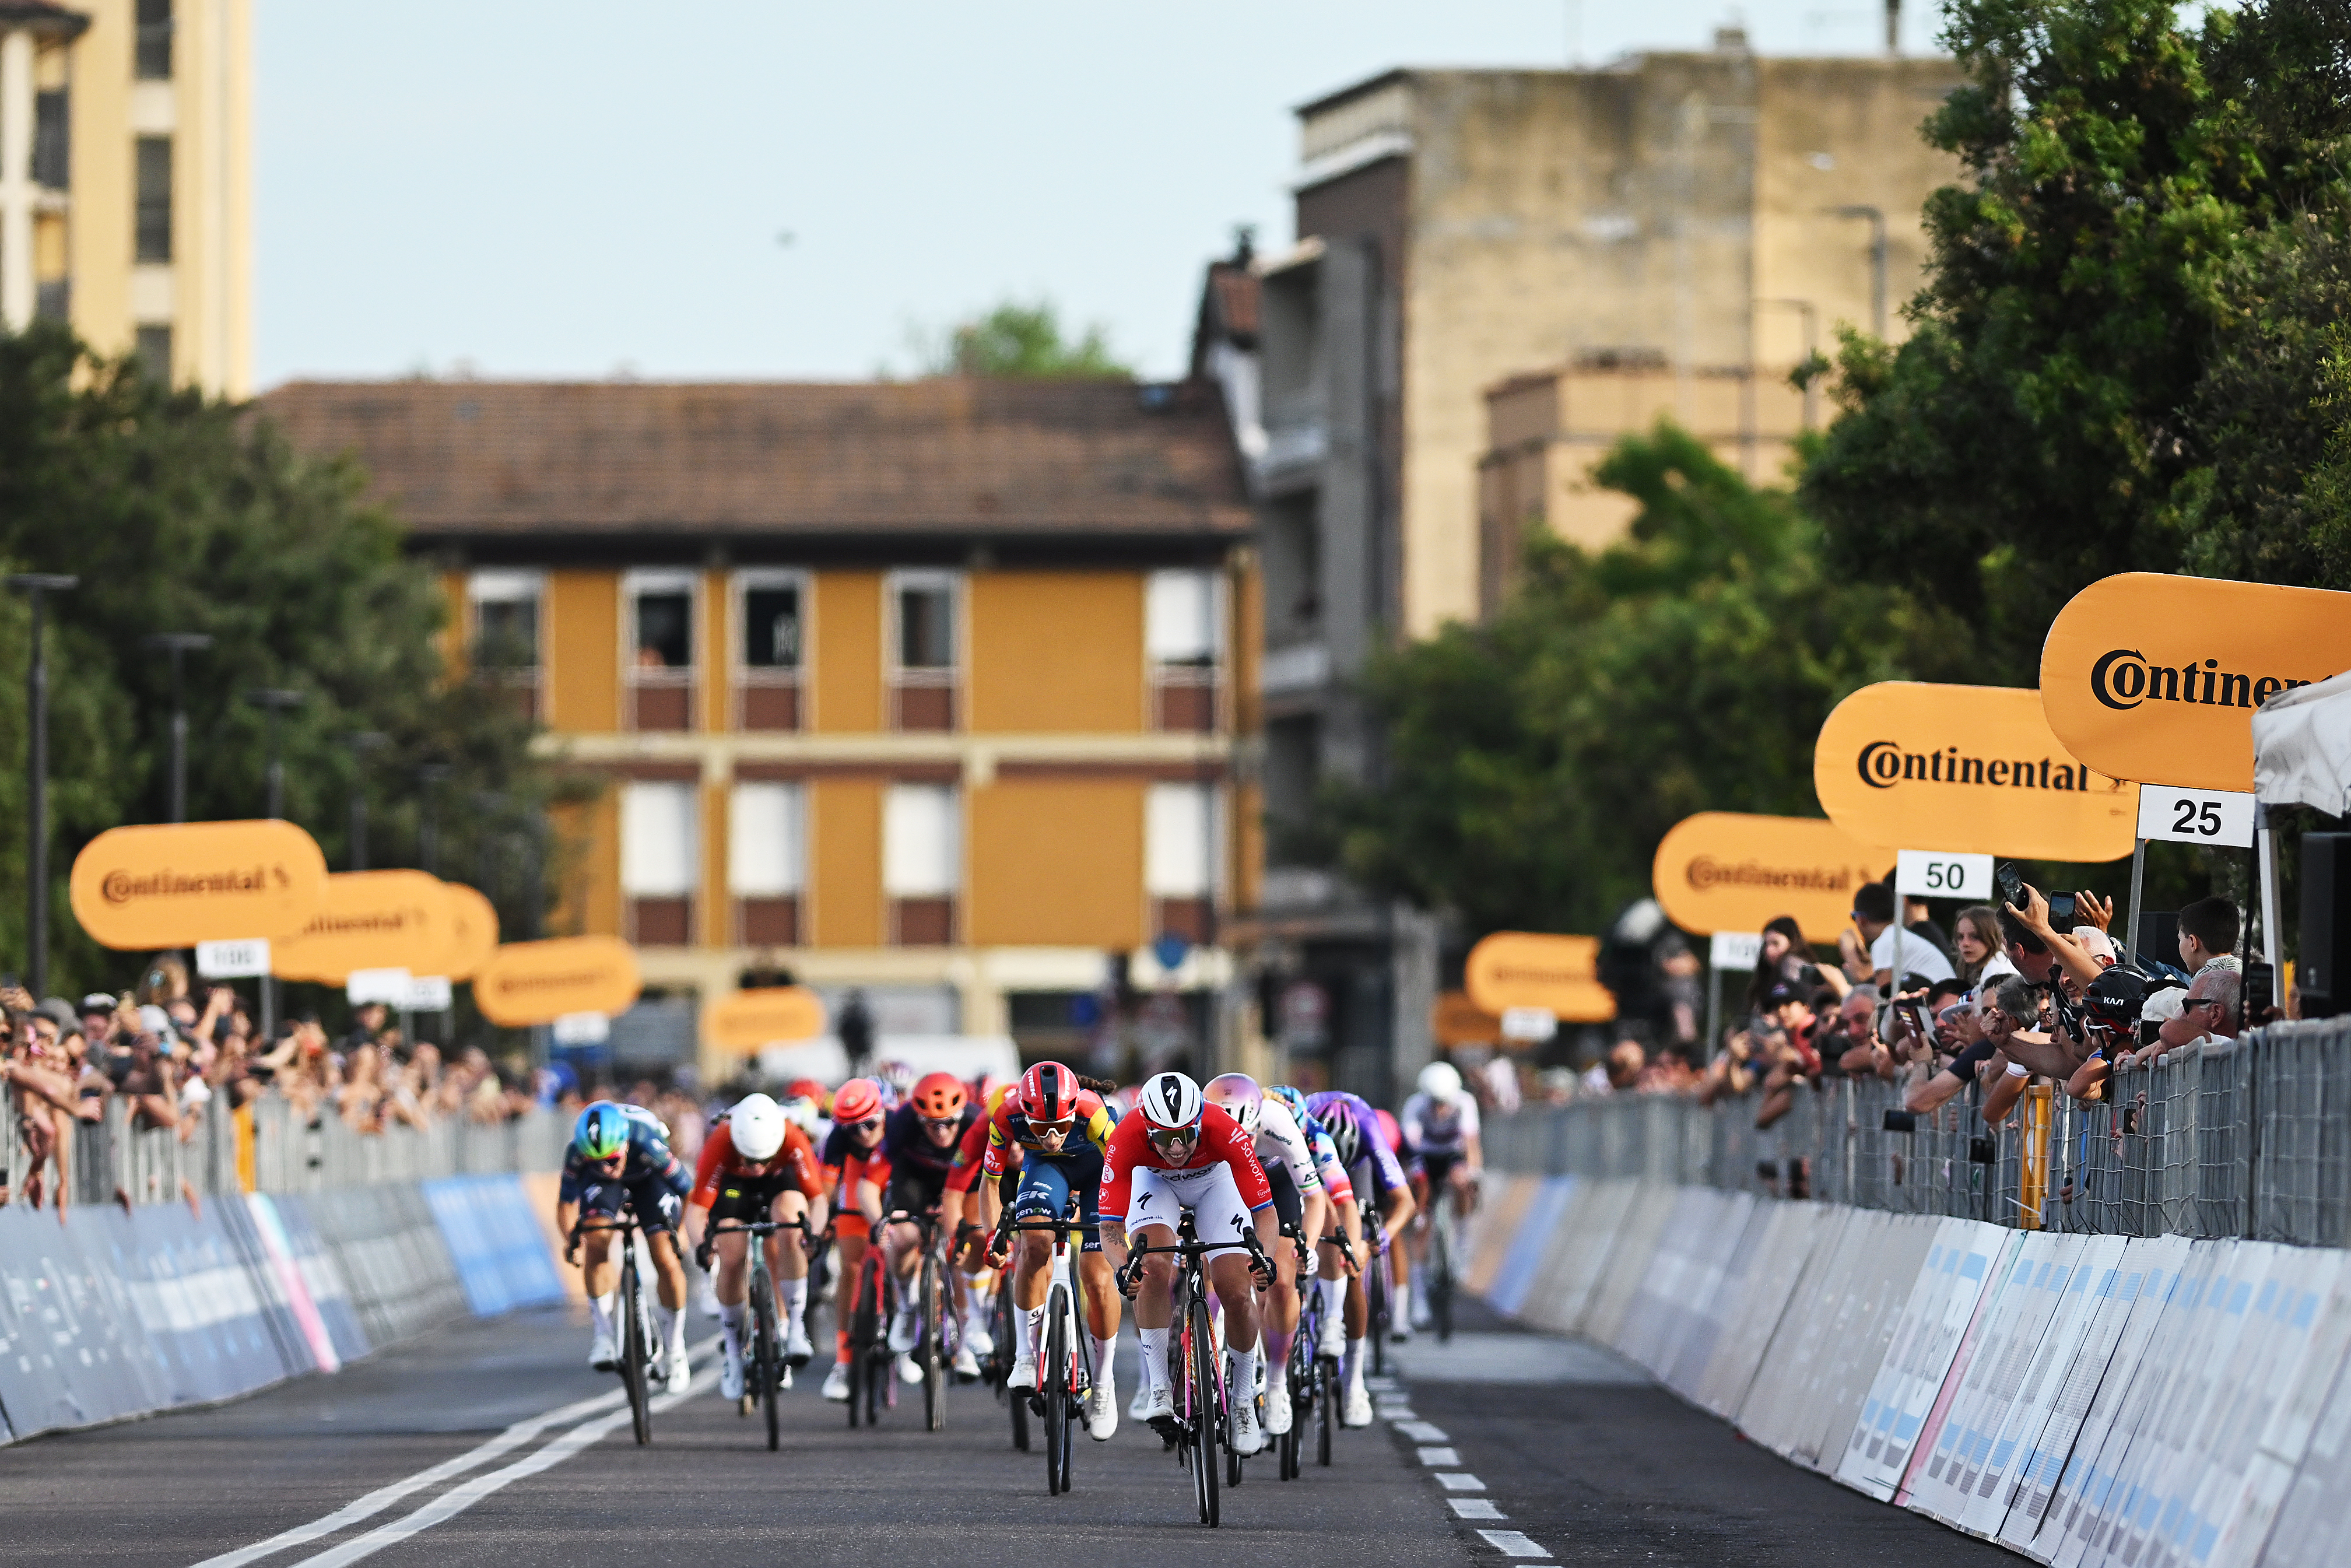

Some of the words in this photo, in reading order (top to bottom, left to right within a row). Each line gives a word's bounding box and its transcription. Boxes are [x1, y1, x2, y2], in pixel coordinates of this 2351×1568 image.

[2091, 648, 2332, 710] Contine
[1858, 740, 2088, 789] Continental
[2172, 799, 2222, 836] 25
[1925, 861, 1965, 891] 50
[1027, 1070, 1037, 1097] TREK
[1103, 1144, 1117, 1182] protime
[1241, 1142, 1266, 1185] sdworx
[1016, 1190, 1050, 1204] EK
[1016, 1207, 1051, 1220] cenow
[1130, 1216, 1155, 1227] dolmans
